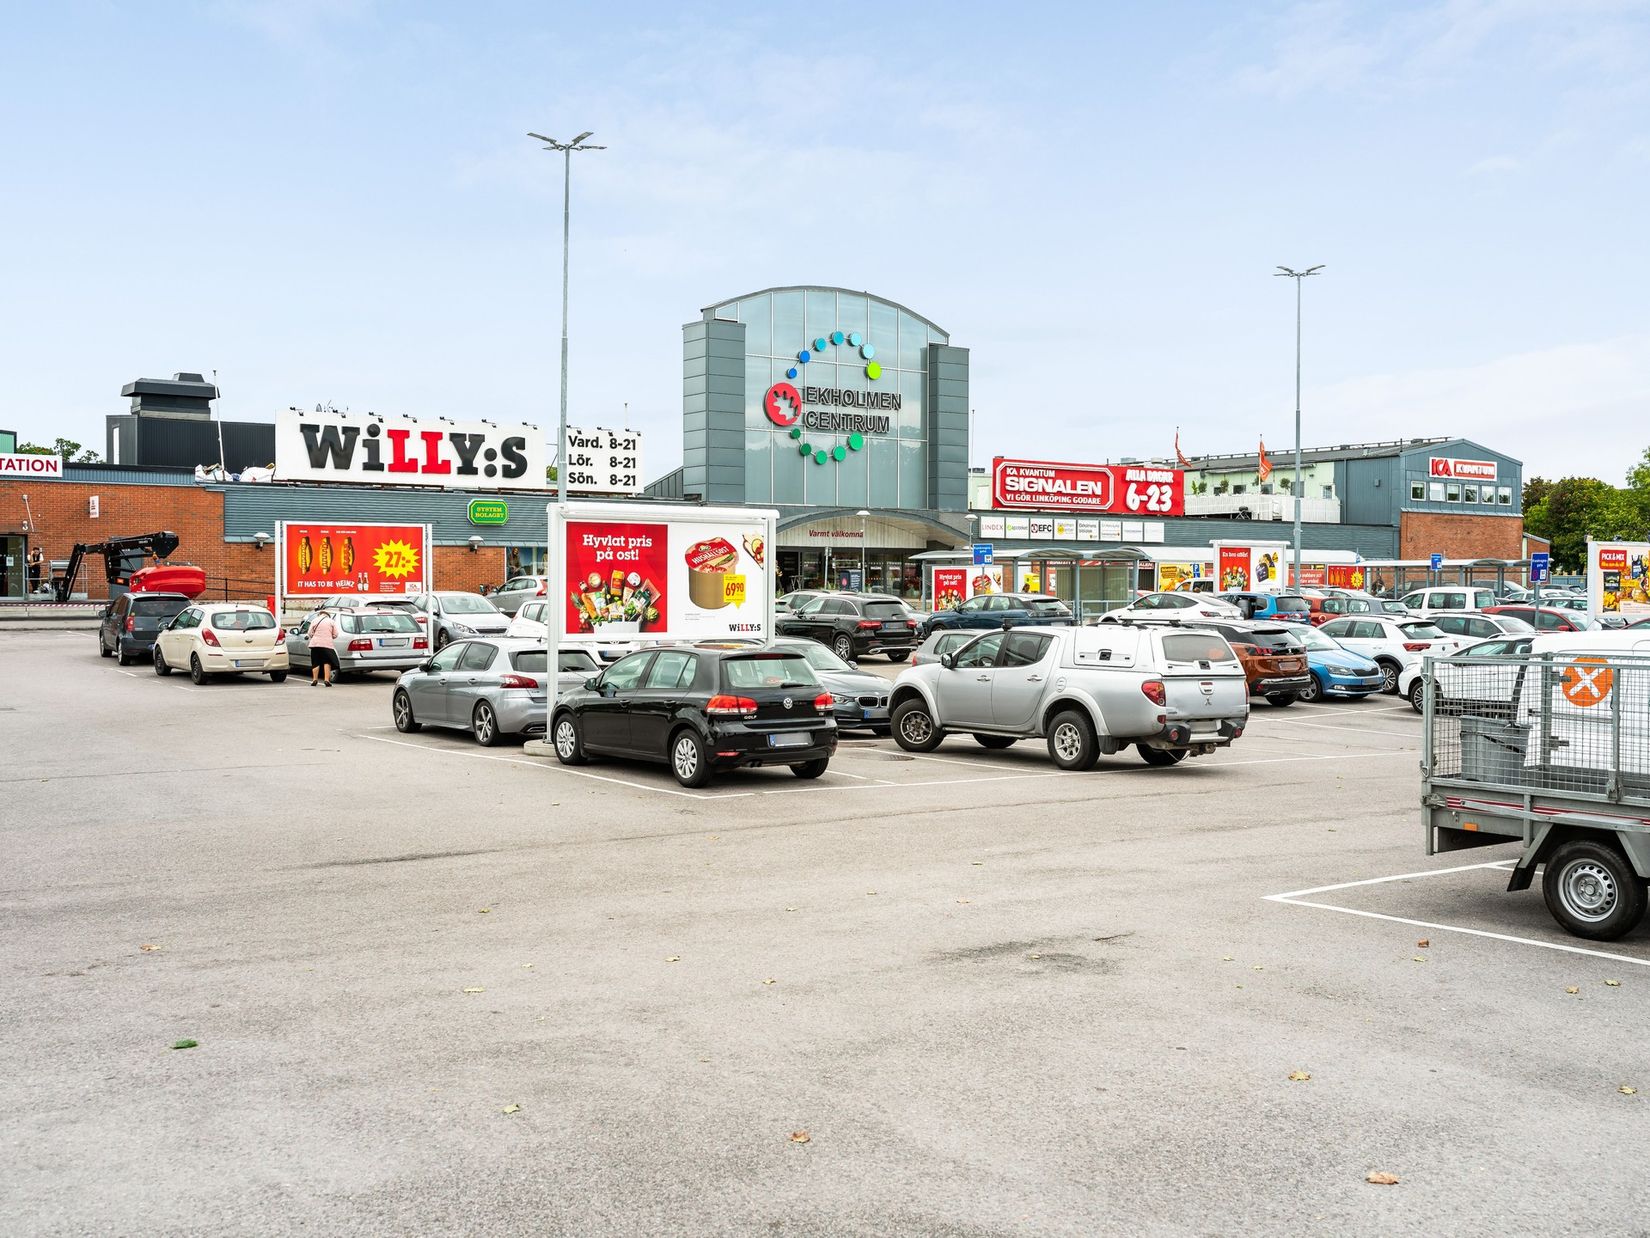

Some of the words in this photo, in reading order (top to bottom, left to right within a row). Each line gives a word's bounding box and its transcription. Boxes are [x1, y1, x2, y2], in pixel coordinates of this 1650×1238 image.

[806, 386, 901, 410] EKHOLMEN
[805, 411, 890, 433] CENTRUM
[300, 423, 528, 478] WiLLY:S
[568, 435, 603, 449] Vard.
[609, 438, 636, 451] 8-21
[568, 454, 593, 467] Lör.
[609, 457, 636, 469] 8-21
[1431, 458, 1452, 477] ICA
[1456, 464, 1495, 476] KVANTUM
[568, 472, 597, 485] Sön.
[609, 474, 636, 486] 8-21
[1020, 468, 1055, 477] KVANTUM
[1126, 469, 1146, 481] ALLA
[1146, 470, 1174, 483] DAGAR
[1005, 477, 1102, 495] SIGNALEN
[1015, 492, 1031, 501] GÖR
[1032, 494, 1071, 503] LINKÖPING
[1126, 482, 1173, 512] 6-23
[583, 535, 626, 548] Hyvlat
[628, 535, 653, 549] pris
[596, 547, 613, 562] på
[617, 549, 639, 560] ost!
[335, 579, 354, 588] HEINZ
[728, 624, 761, 632] WiLLY:S
